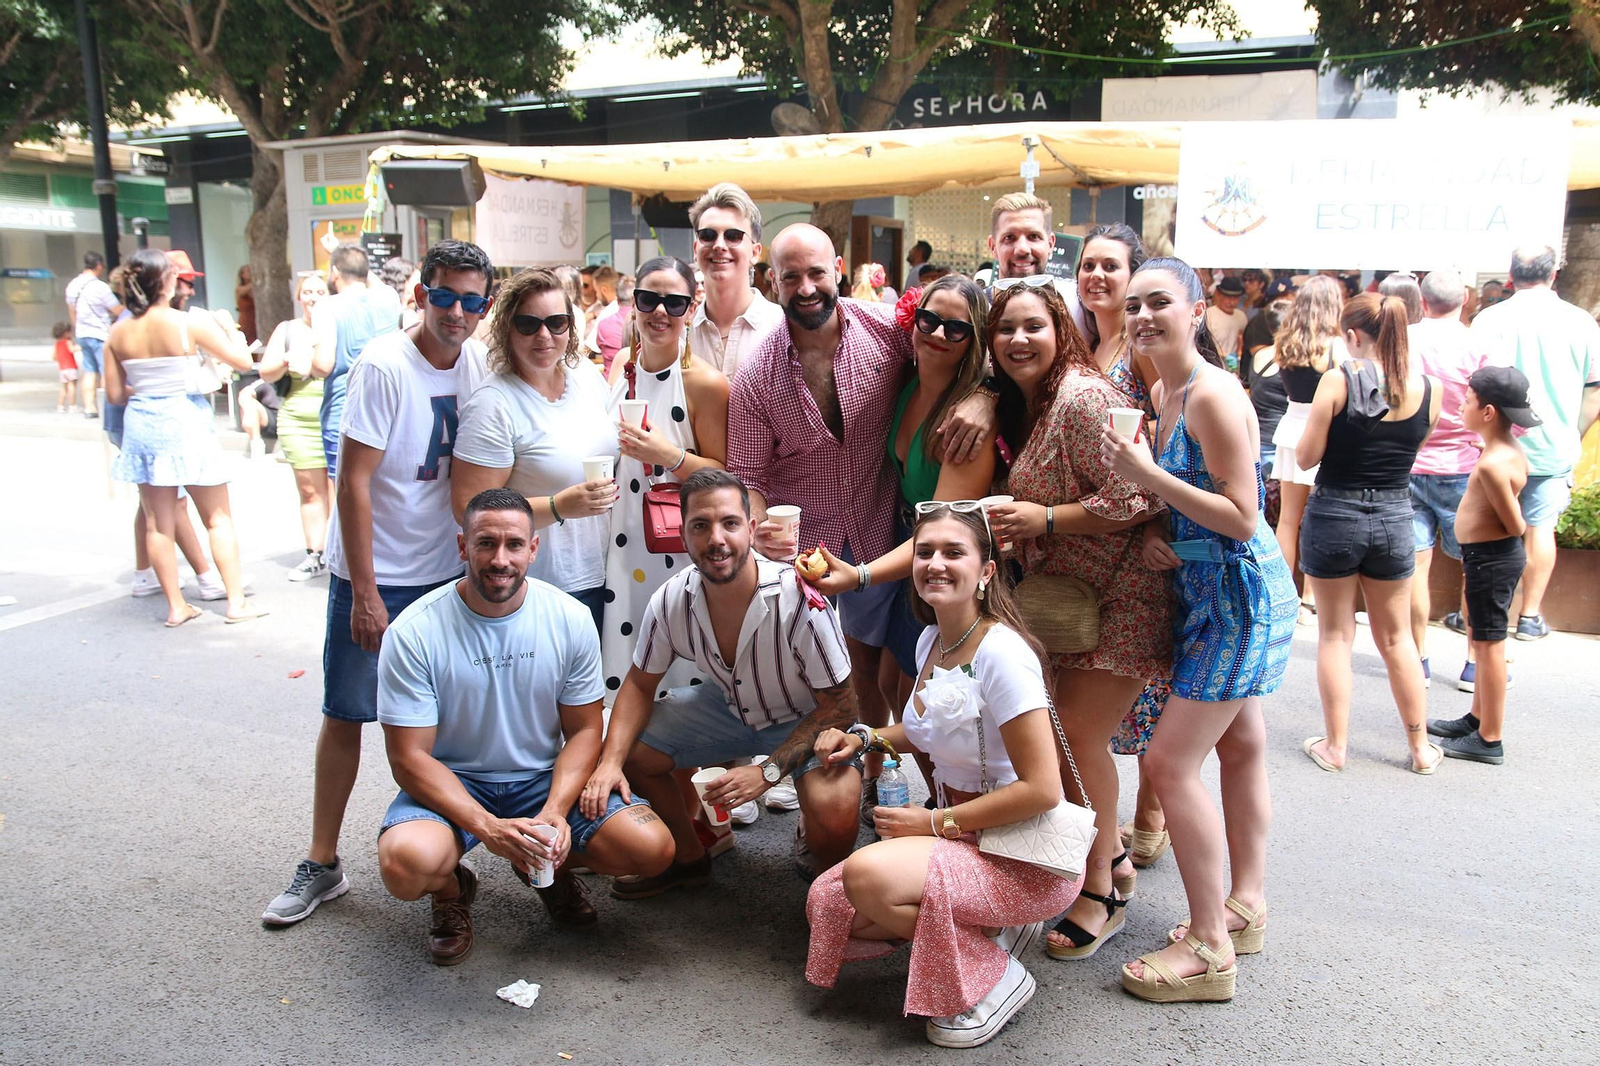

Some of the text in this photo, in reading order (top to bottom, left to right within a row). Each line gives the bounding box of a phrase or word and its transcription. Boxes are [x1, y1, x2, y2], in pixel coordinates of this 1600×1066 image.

[913, 91, 1047, 118] SEPHORA
[331, 187, 366, 201] ONC
[1315, 203, 1509, 231] ESTRELLA
[415, 394, 459, 480] A
[519, 651, 535, 659] VIE
